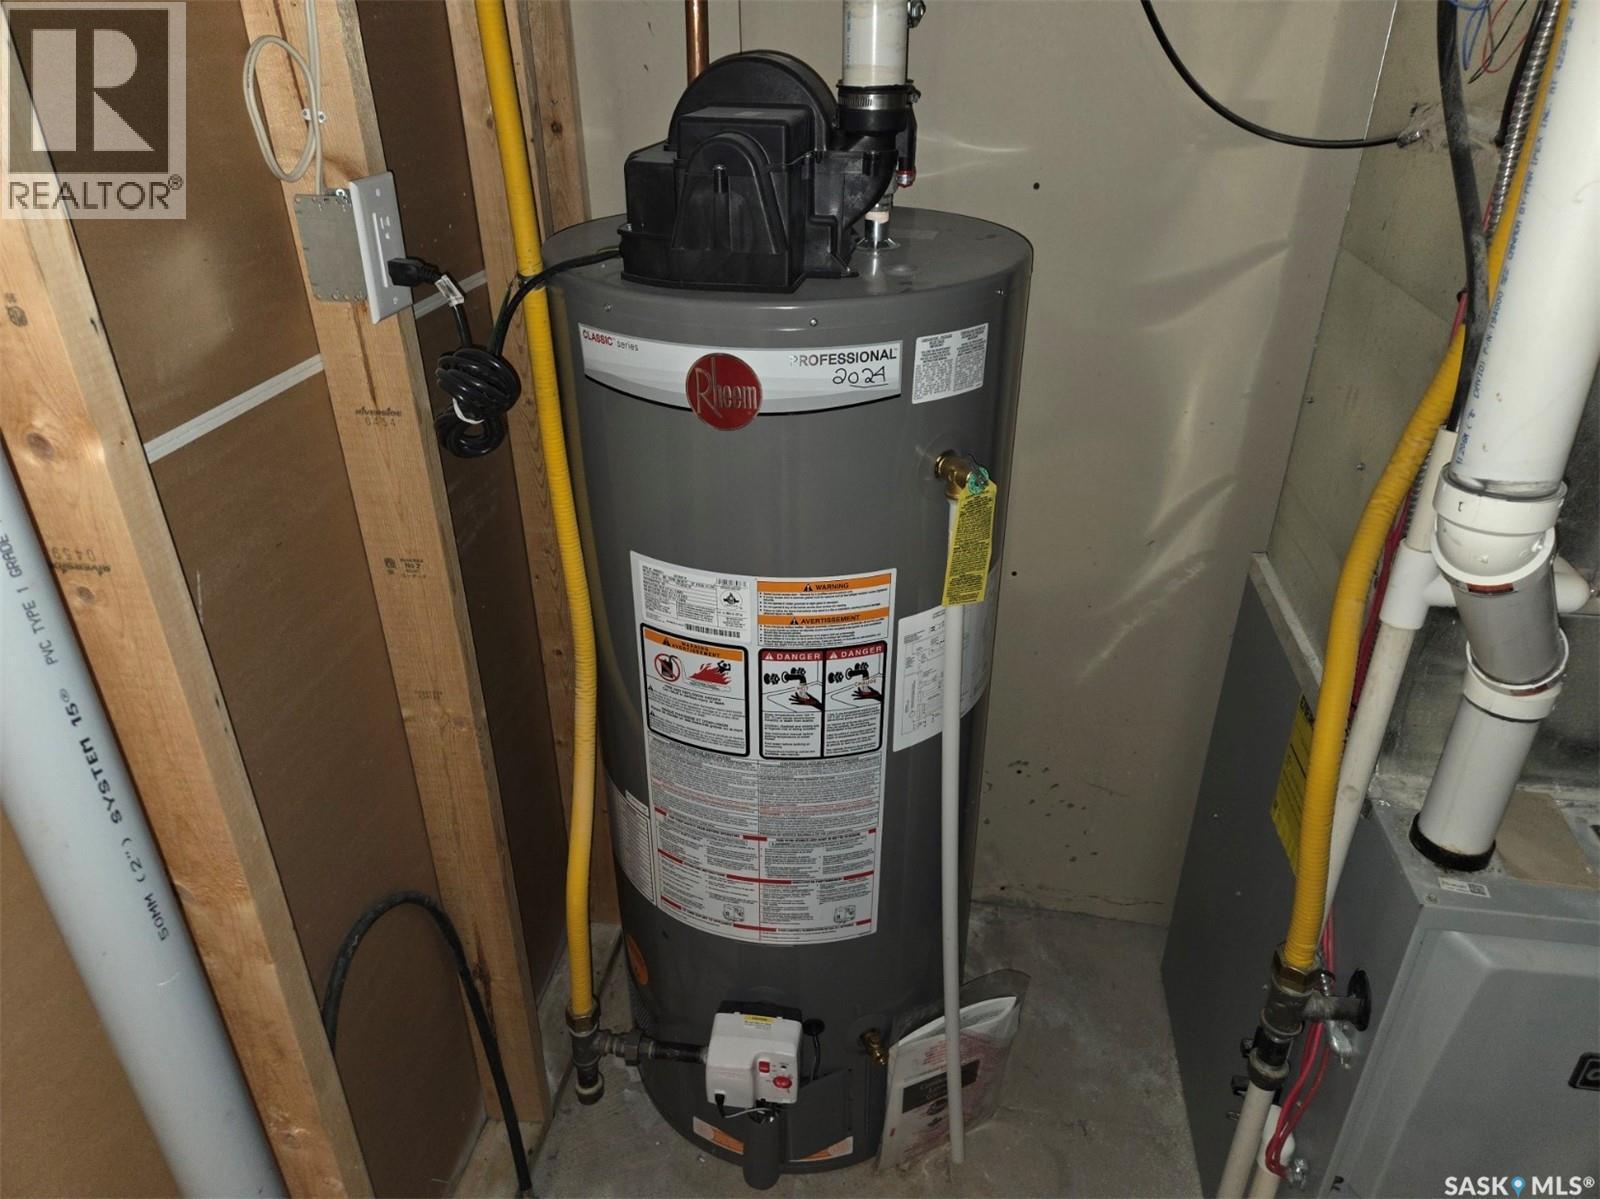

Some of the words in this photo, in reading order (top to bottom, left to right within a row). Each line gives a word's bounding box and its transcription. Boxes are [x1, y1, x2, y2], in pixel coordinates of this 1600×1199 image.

[694, 357, 757, 419] Rheem
[832, 365, 887, 385] 2024
[0, 533, 23, 578] GRADE
[815, 582, 849, 591] WARNING
[22, 600, 45, 634] TYPE
[800, 614, 861, 625] AVERTISSEMENT
[39, 639, 59, 665] PVC
[776, 653, 821, 661] DANGER
[841, 645, 882, 658] DANGER
[79, 736, 123, 824] SYSTEM
[144, 892, 170, 941] 50MM
